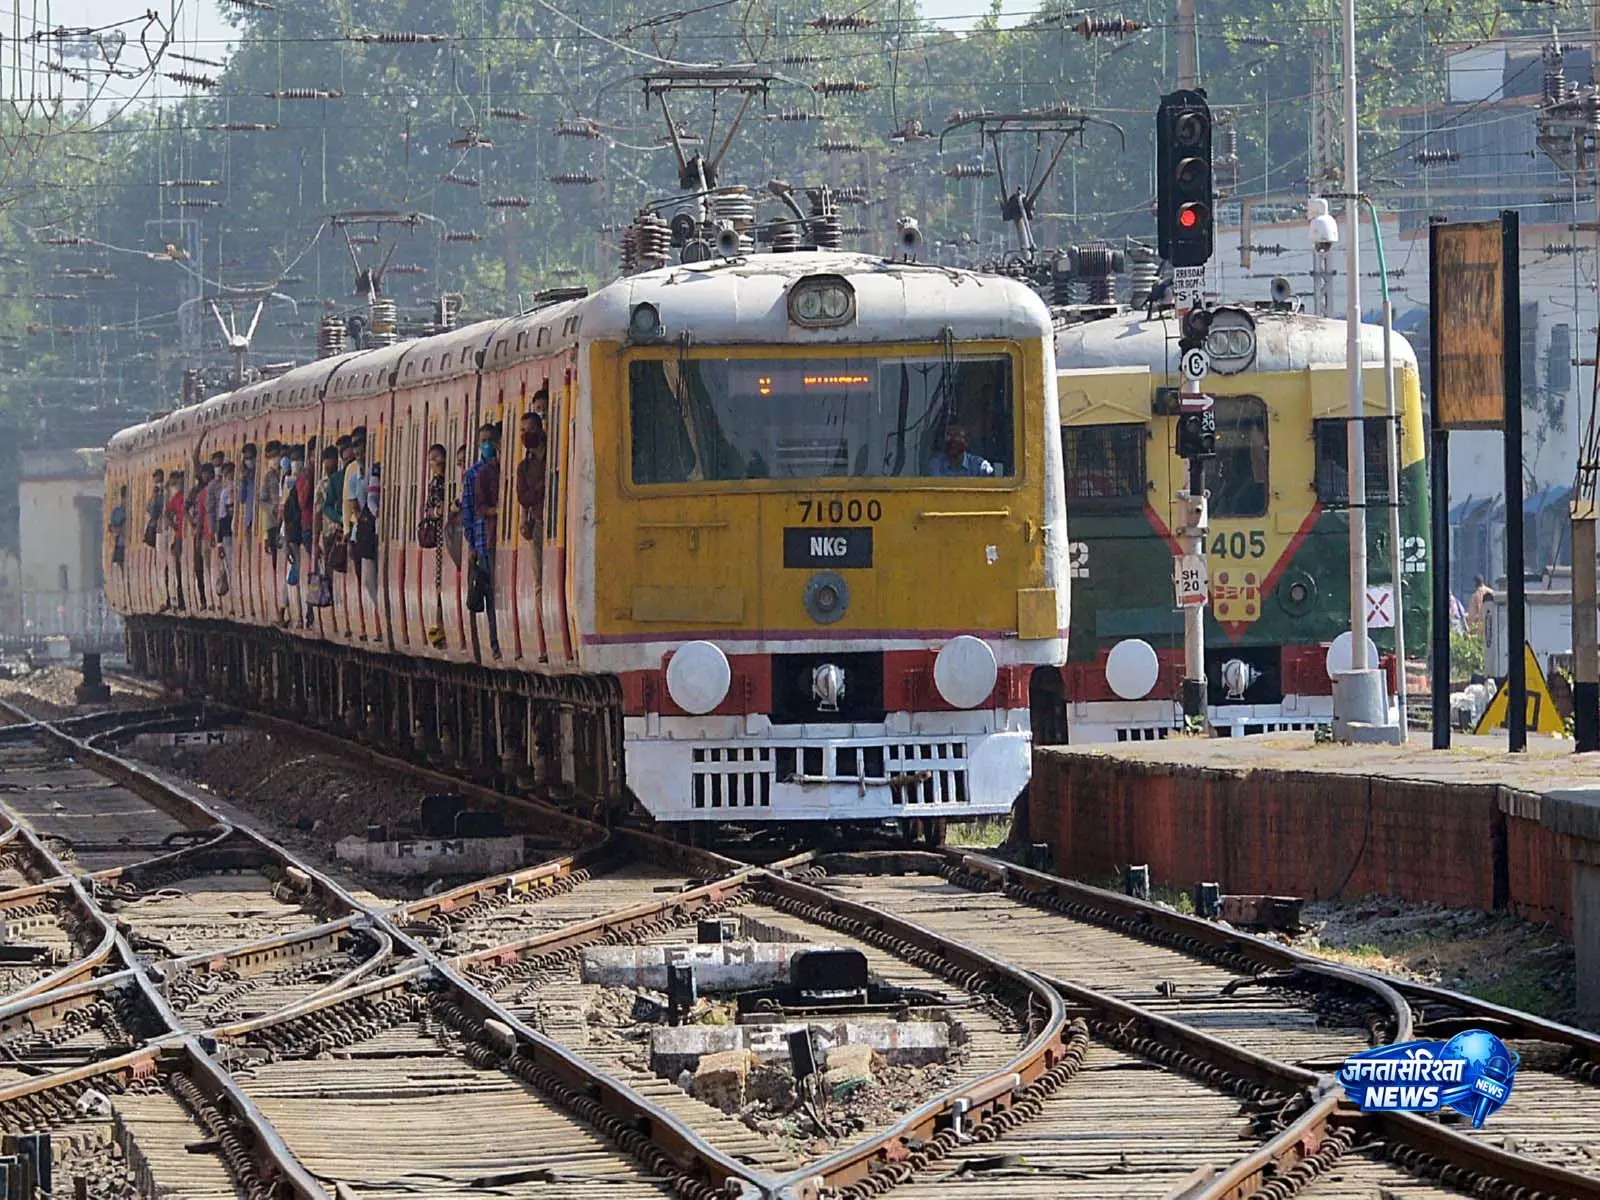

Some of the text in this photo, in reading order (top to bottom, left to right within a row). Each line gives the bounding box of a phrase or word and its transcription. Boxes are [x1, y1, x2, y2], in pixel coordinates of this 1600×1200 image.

[1203, 411, 1215, 420] SH
[798, 499, 882, 523] 71000
[810, 536, 848, 556] NKG
[1182, 570, 1199, 580] SH
[1184, 581, 1199, 592] 20
